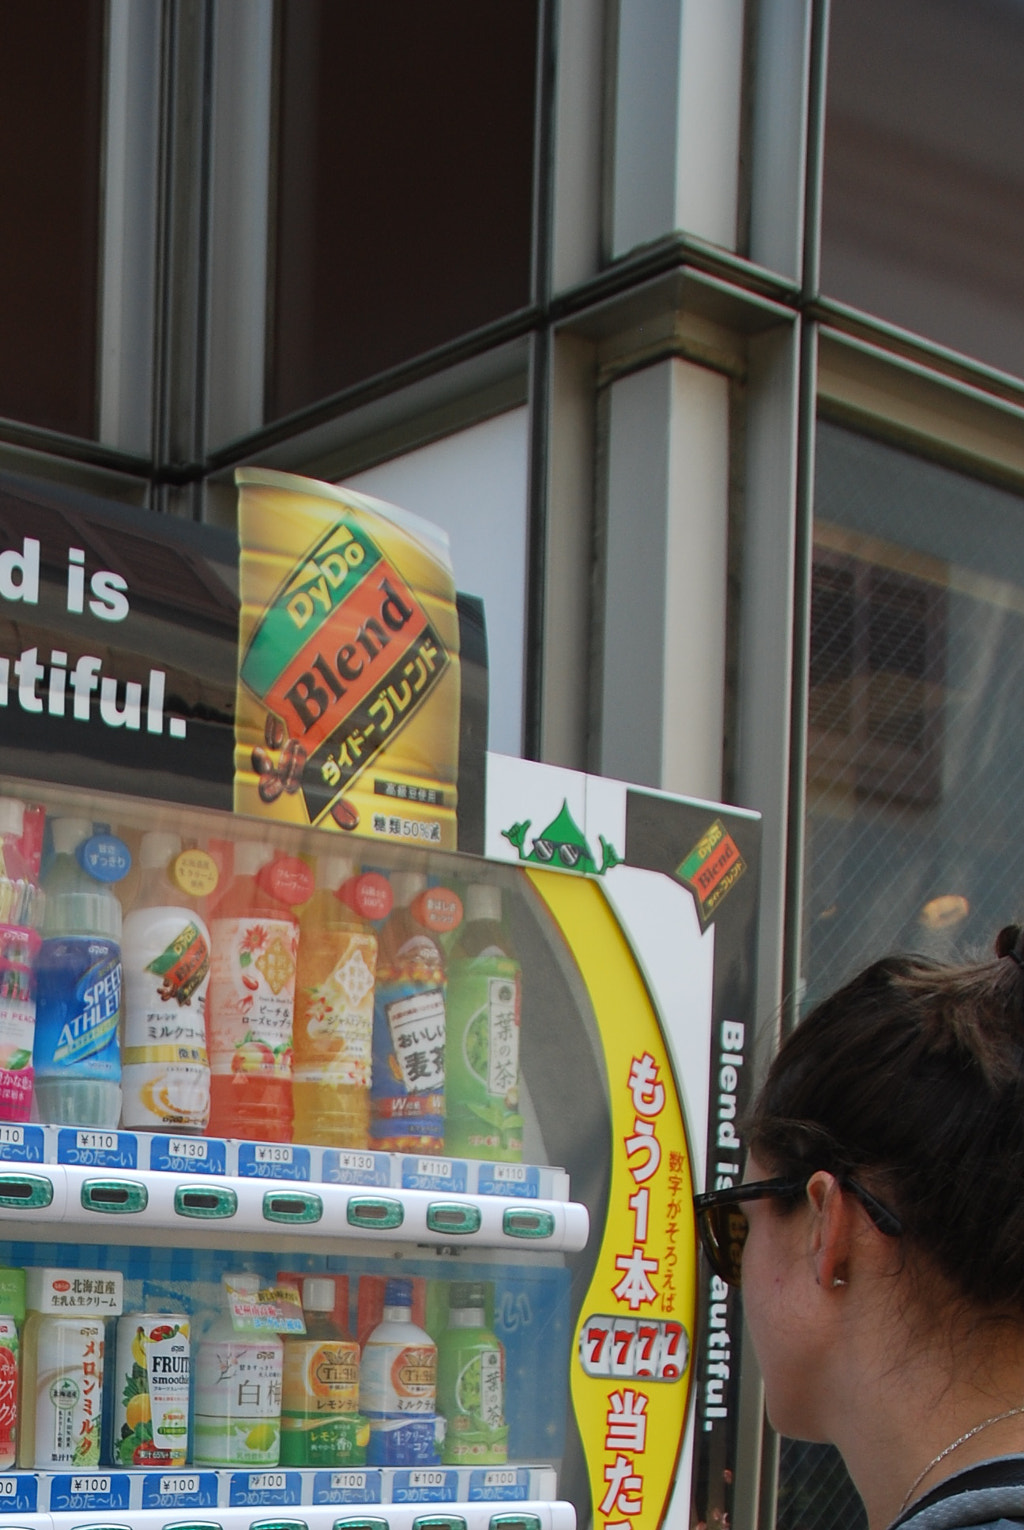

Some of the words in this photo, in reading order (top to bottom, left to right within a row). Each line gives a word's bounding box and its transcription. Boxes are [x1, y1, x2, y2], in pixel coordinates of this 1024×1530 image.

[67, 547, 130, 622] is
[286, 527, 366, 631] DyDo
[283, 582, 414, 735] Blend
[320, 637, 445, 787] ダイドーブレンド
[374, 813, 442, 844] 糖類50%減
[698, 826, 722, 859] DyDo
[89, 853, 125, 869] すっきり
[698, 843, 733, 889] Blend
[718, 1020, 744, 1149] Blend
[81, 1134, 114, 1148] ¥110
[173, 1142, 205, 1157] ¥130
[260, 1148, 290, 1162] ¥130
[343, 1155, 373, 1169] ¥130
[421, 1160, 449, 1176] ¥110
[497, 1167, 524, 1181] ¥110
[716, 1162, 739, 1190] is
[611, 1051, 667, 1311] もう1本
[660, 1151, 686, 1313] 数字がそろえば
[71, 1279, 116, 1295] 北海道産
[51, 1295, 117, 1308] 生乳&生クリーム
[587, 1323, 683, 1365] 7777
[79, 1340, 97, 1456] メロンミルク
[74, 1478, 108, 1492] ¥100
[162, 1478, 195, 1492] ¥100
[414, 1472, 442, 1485] ¥100
[485, 1472, 513, 1485] ¥100
